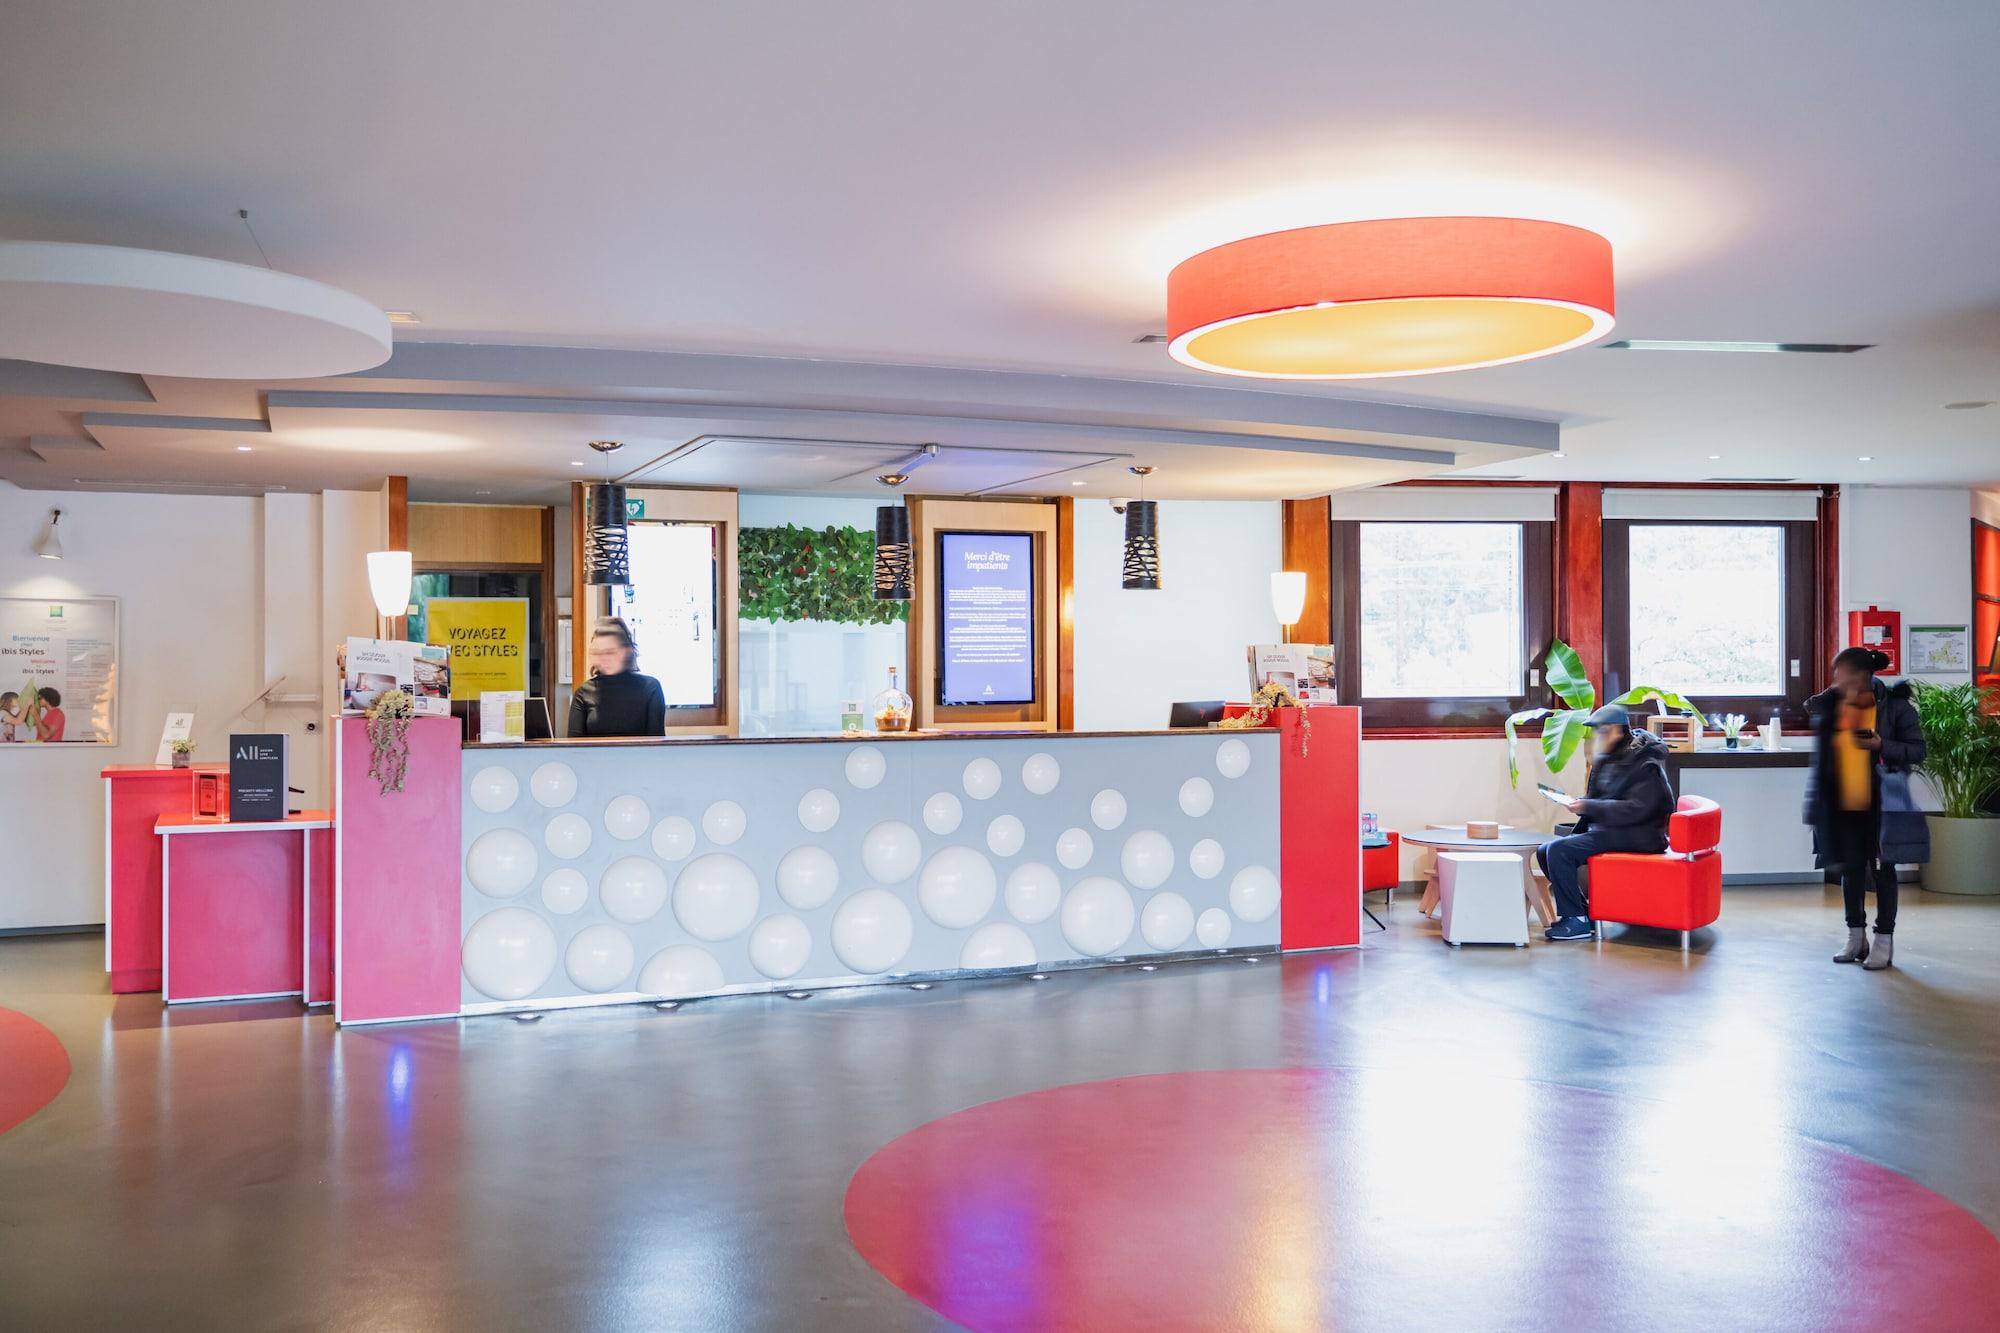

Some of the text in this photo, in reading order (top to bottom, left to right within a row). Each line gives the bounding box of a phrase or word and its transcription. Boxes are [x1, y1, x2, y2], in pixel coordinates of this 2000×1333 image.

[964, 551, 988, 561] Merci
[449, 627, 507, 640] VOYAGEZ
[19, 648, 45, 656] Styles
[450, 645, 518, 657] EC STYLES
